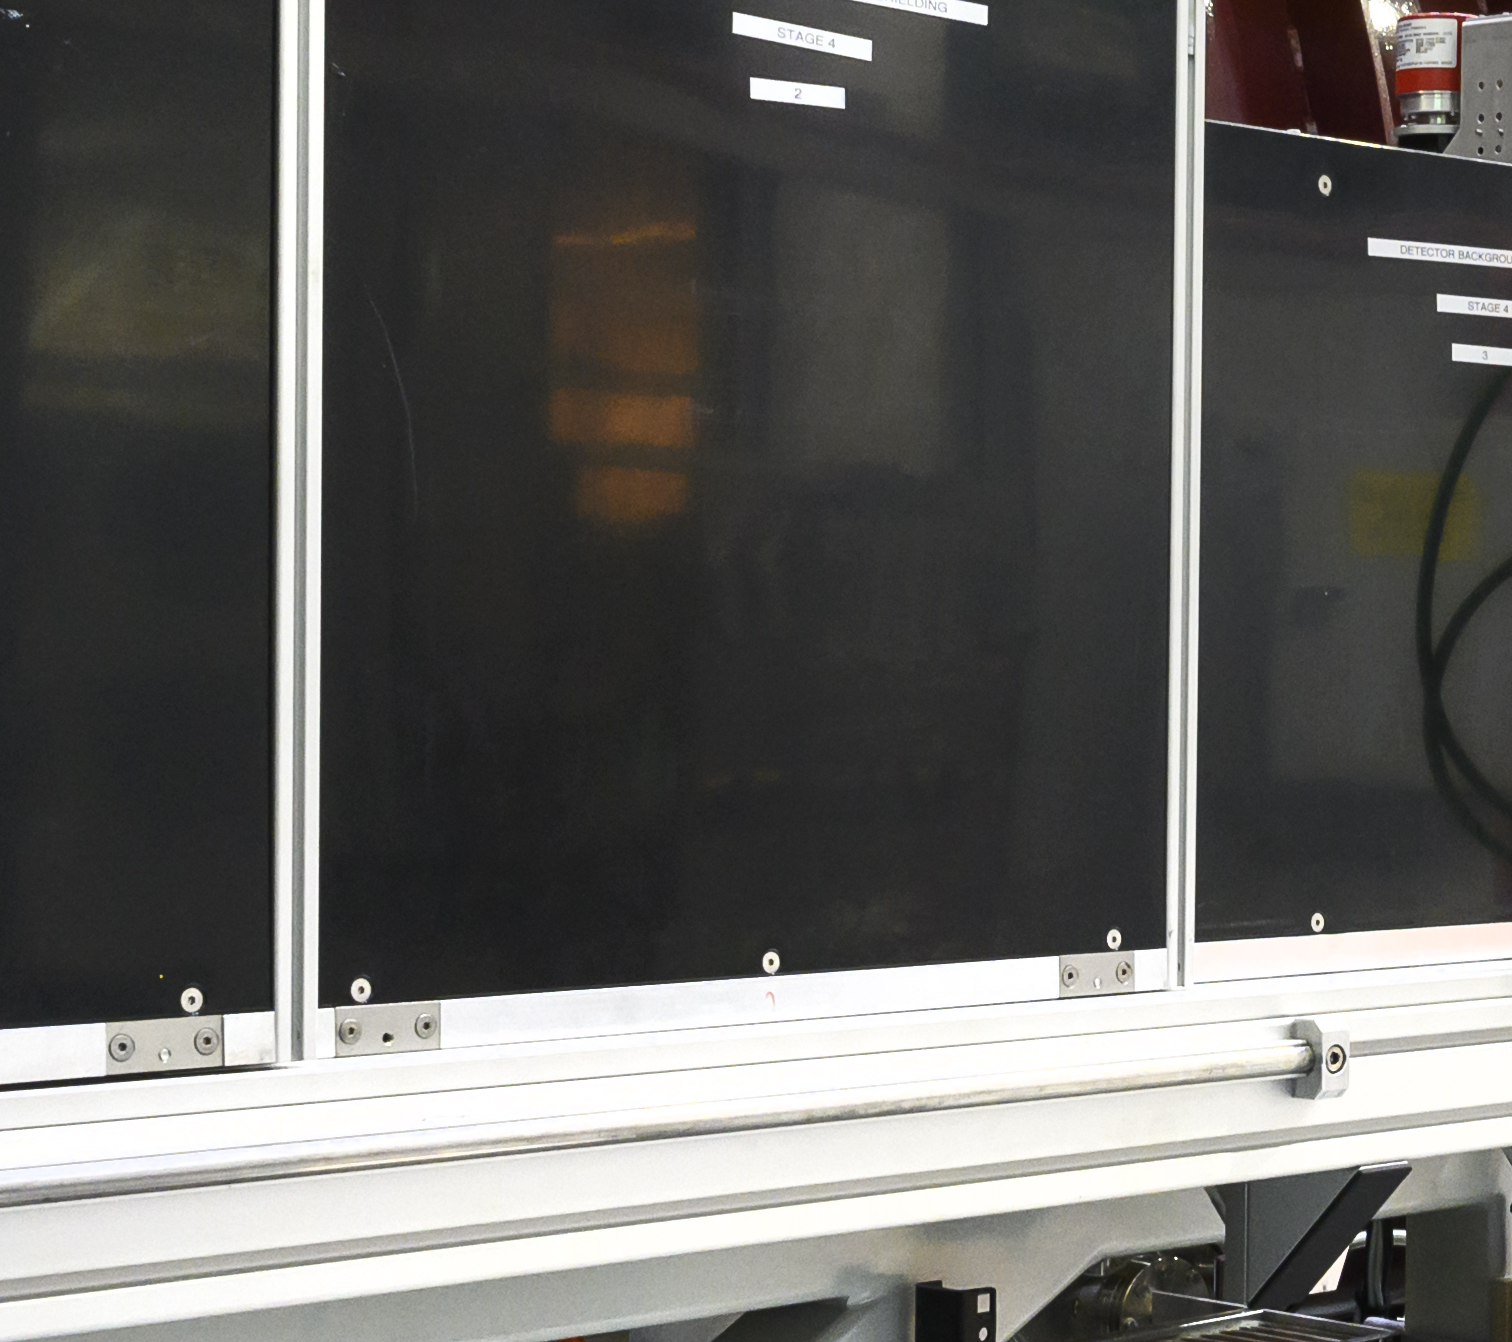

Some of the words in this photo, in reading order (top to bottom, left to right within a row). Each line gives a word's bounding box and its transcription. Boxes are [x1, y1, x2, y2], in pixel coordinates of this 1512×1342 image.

[777, 26, 824, 47] STAGE
[828, 38, 836, 49] 4
[794, 87, 803, 99] 2
[1400, 244, 1455, 259] DETECTOR
[1467, 300, 1500, 313] STAGE
[1503, 304, 1509, 314] 4
[1481, 350, 1489, 360] 3
